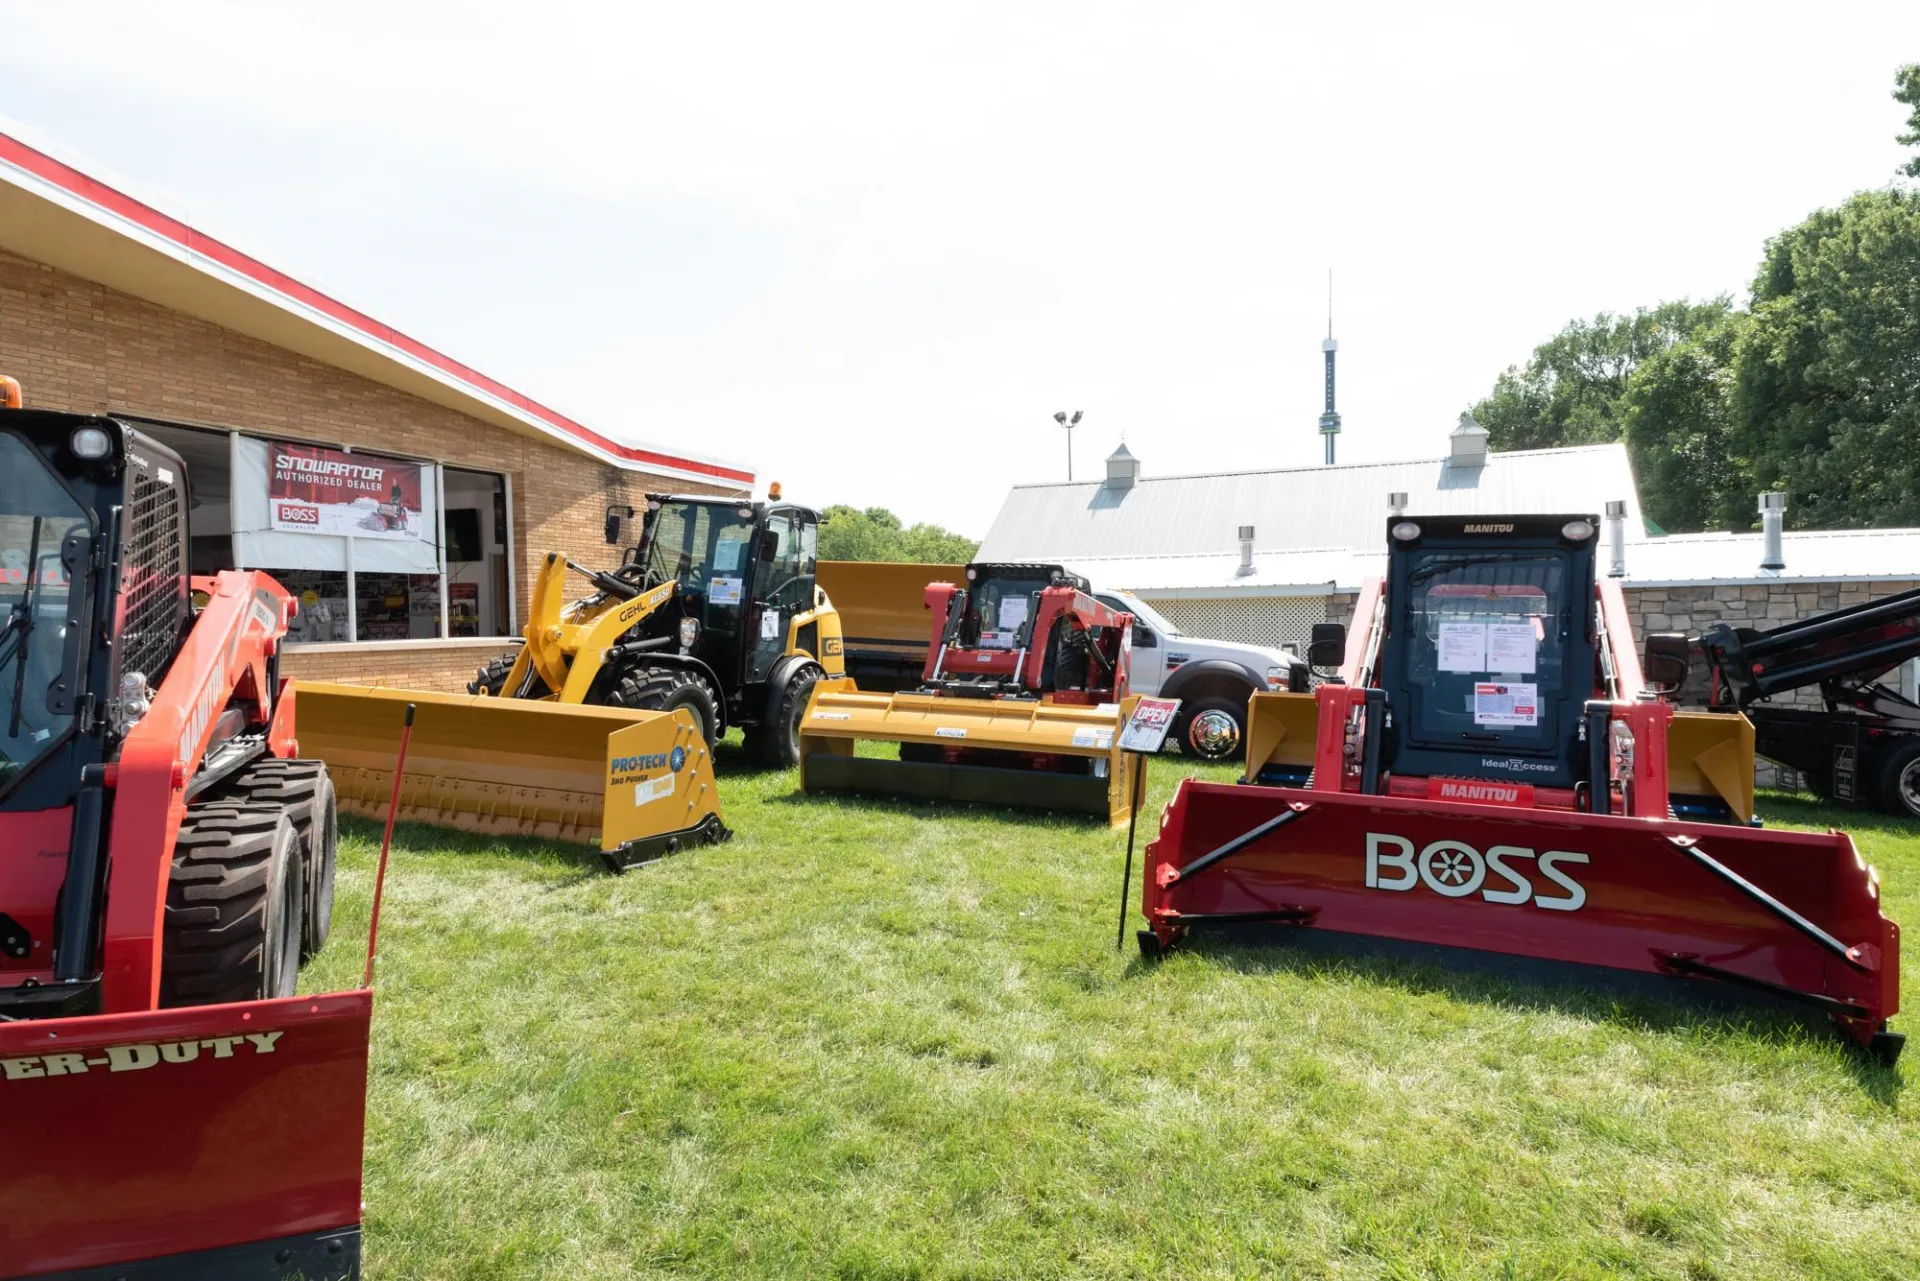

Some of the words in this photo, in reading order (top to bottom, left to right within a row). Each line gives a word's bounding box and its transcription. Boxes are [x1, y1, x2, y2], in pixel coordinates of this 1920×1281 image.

[275, 454, 384, 481] SNOWRATOR
[276, 470, 343, 487] AUTHORIZED
[347, 479, 383, 492] DEALER
[281, 507, 316, 522] BOSS
[1463, 523, 1514, 534] MANITOU
[619, 601, 647, 623] GEHL
[1136, 705, 1171, 723] OPEN
[1440, 782, 1518, 803] MANITOU
[1364, 831, 1591, 912] BOSS
[0, 1030, 284, 1081] ER-DUTY
